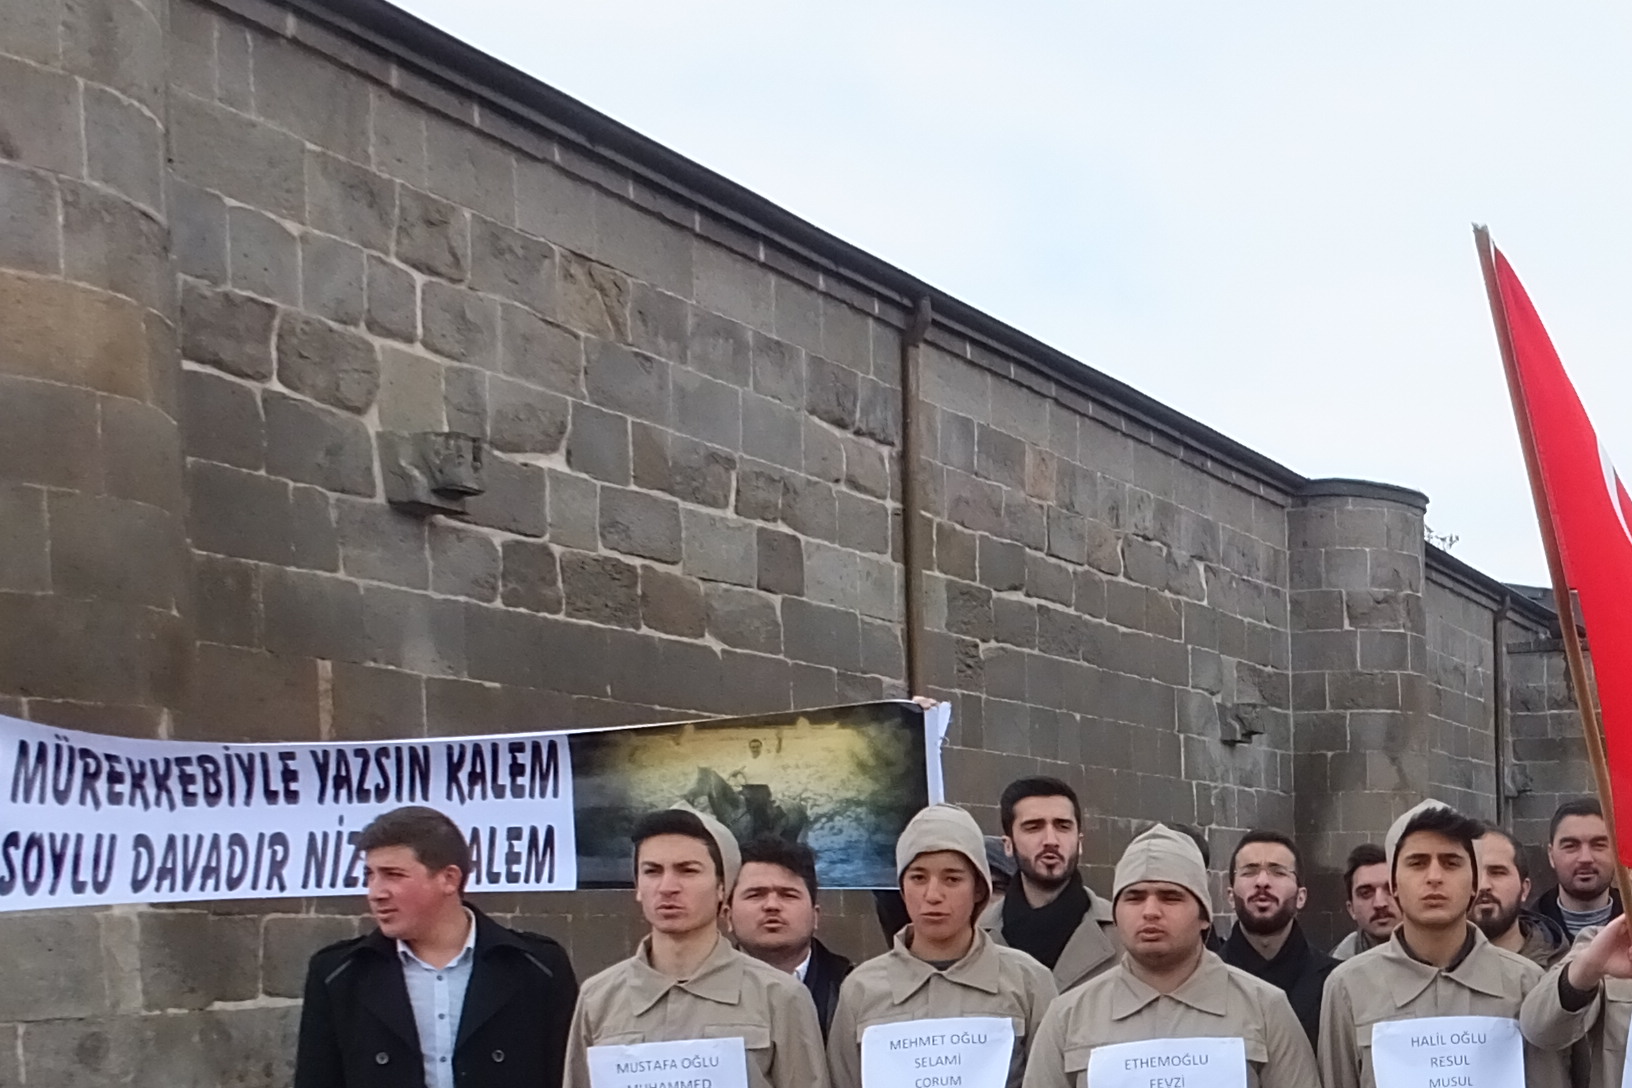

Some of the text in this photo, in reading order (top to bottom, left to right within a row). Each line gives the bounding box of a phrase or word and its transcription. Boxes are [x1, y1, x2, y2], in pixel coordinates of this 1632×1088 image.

[10, 734, 560, 812] MÜREKKEBİYLE YAZSIN KALEM
[0, 830, 117, 896] SOYLU
[130, 831, 291, 894] DAVADIR
[889, 1031, 988, 1050] MEHMET OĞLU
[1411, 1031, 1487, 1048] HALİL OĞLU
[616, 1054, 719, 1074] MUSTAFA OĞLU
[914, 1053, 962, 1069] SELAMİ
[1124, 1053, 1209, 1071] ETHEMOĞLU
[1430, 1055, 1471, 1068] RESUL
[1429, 1076, 1474, 1088] MUSUL
